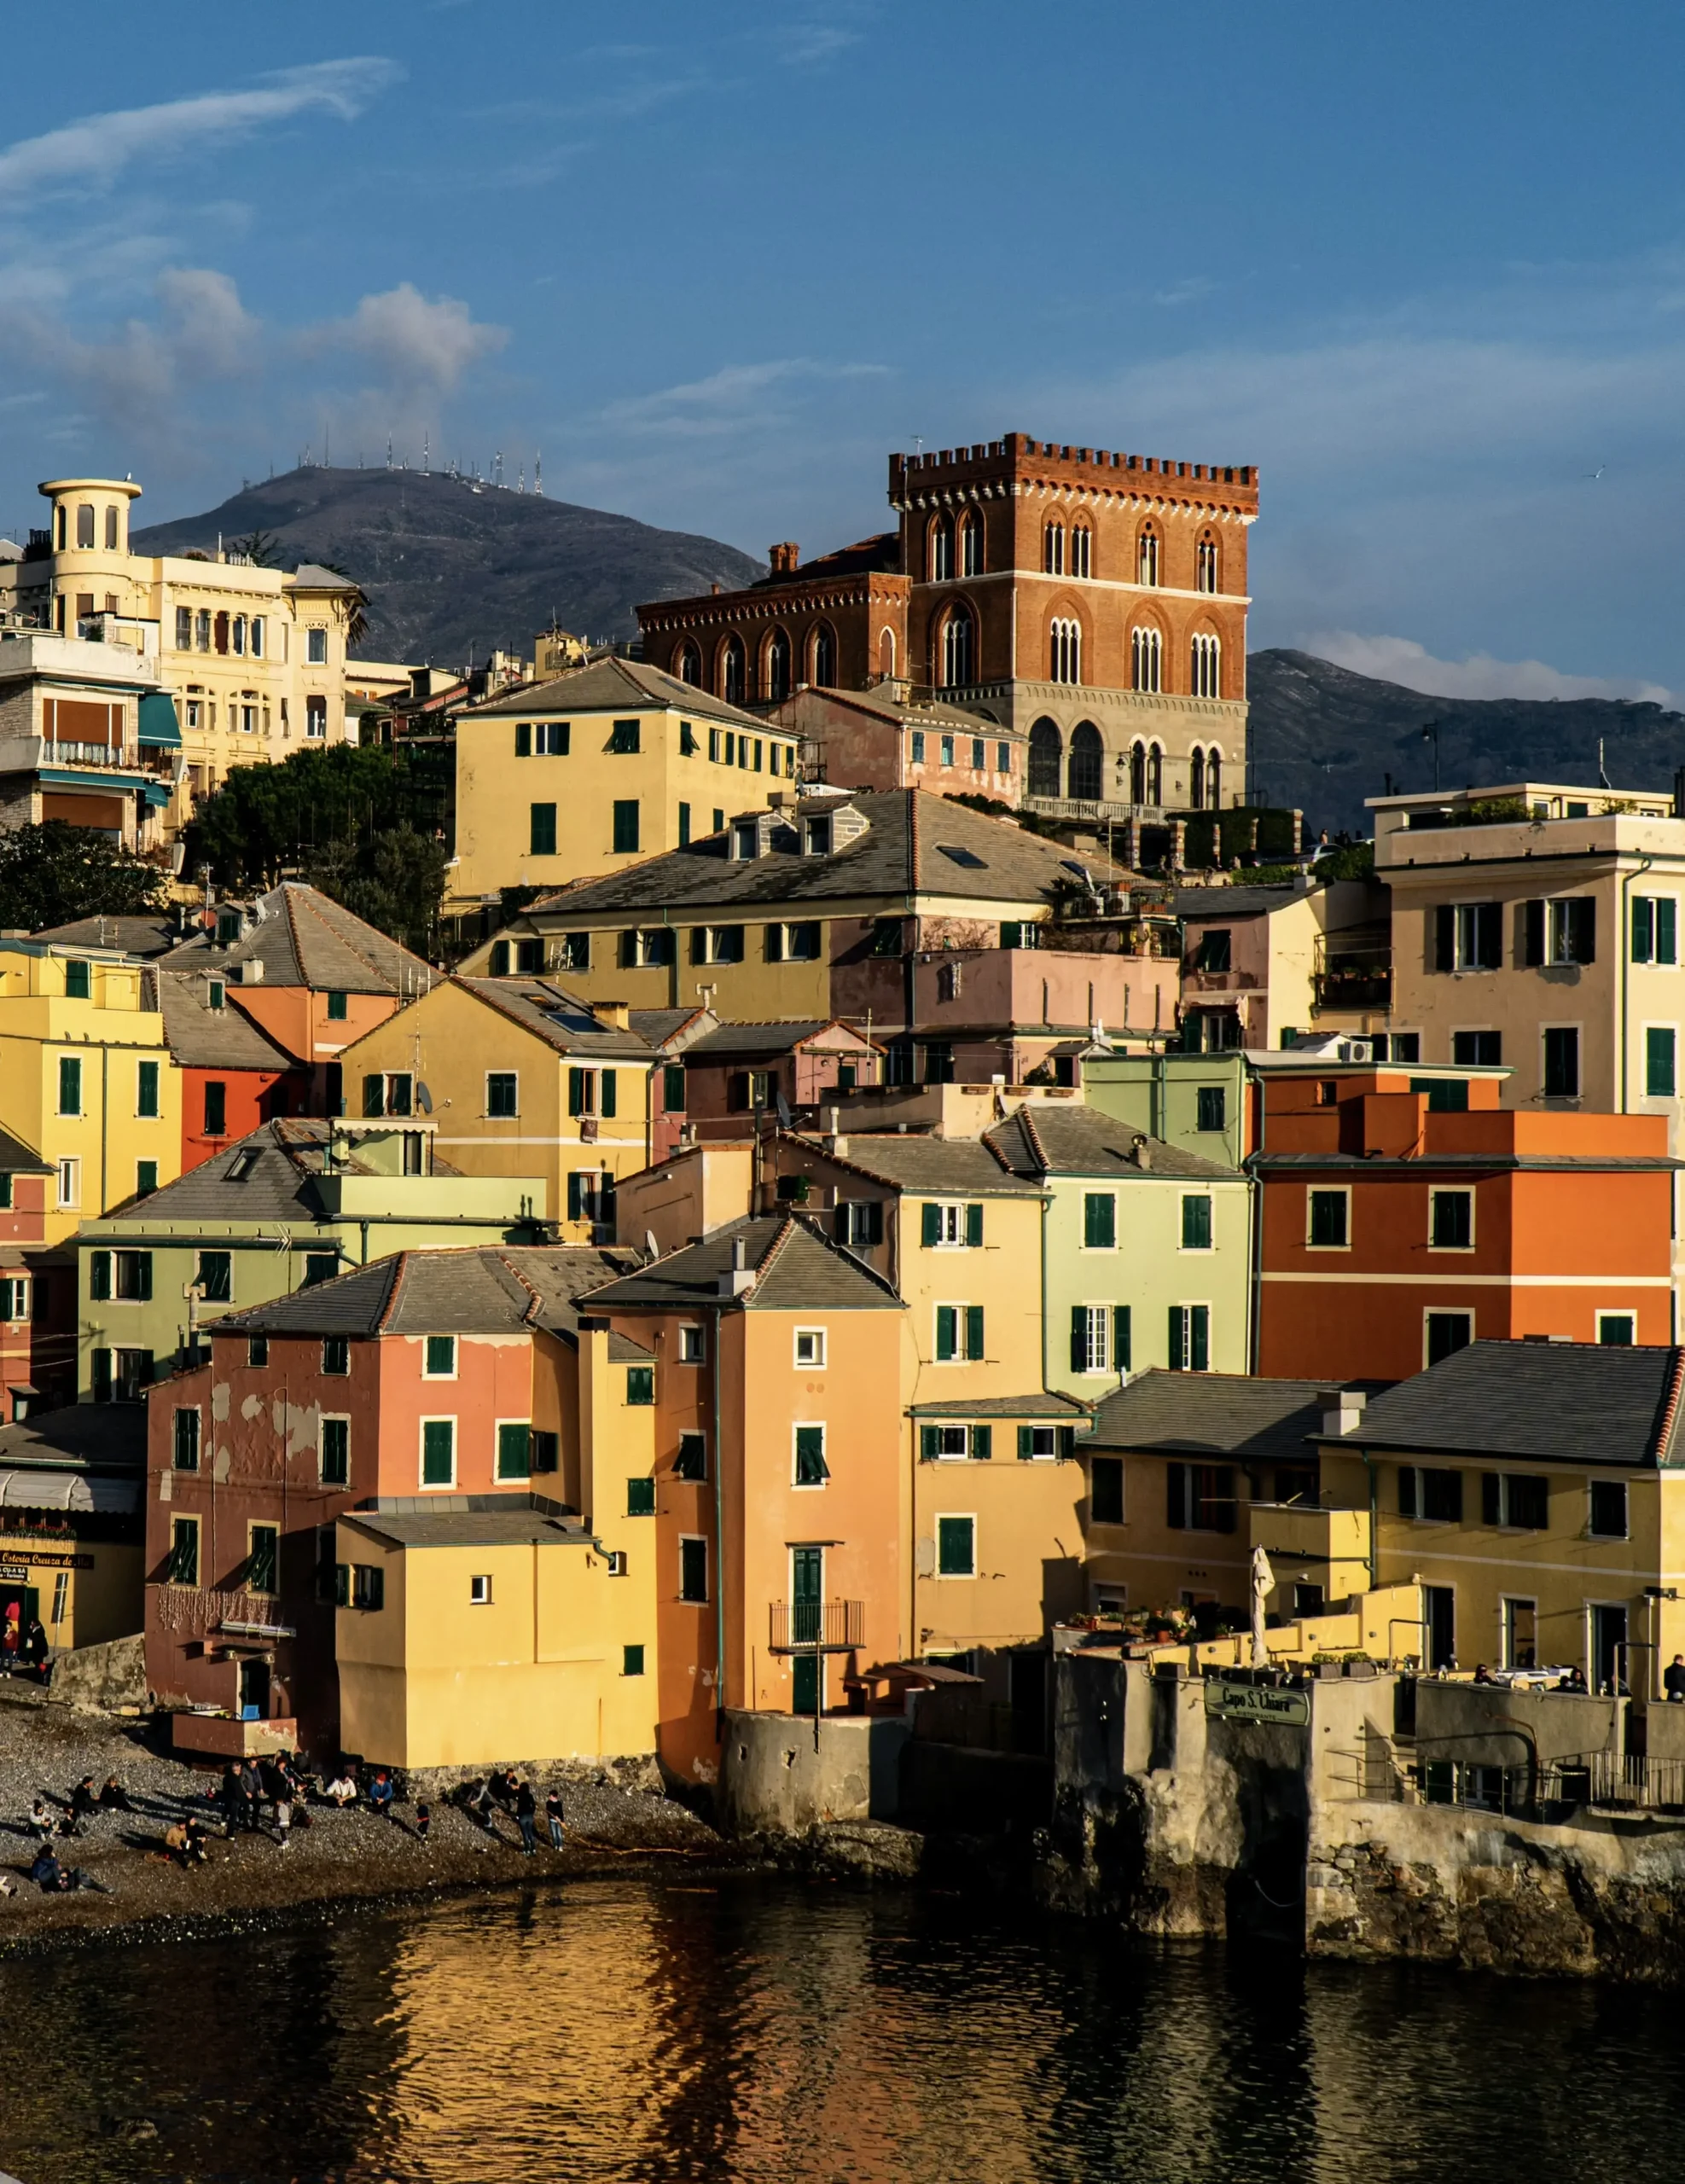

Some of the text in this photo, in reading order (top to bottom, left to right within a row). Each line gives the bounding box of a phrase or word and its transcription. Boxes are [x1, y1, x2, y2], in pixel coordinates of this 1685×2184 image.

[3, 1552, 30, 1564] Osteria
[32, 1554, 61, 1565] Creuza
[62, 1556, 73, 1566] de
[1223, 1687, 1291, 1713] Capo S. Chiara
[1235, 1710, 1276, 1721] RISTORANTE
